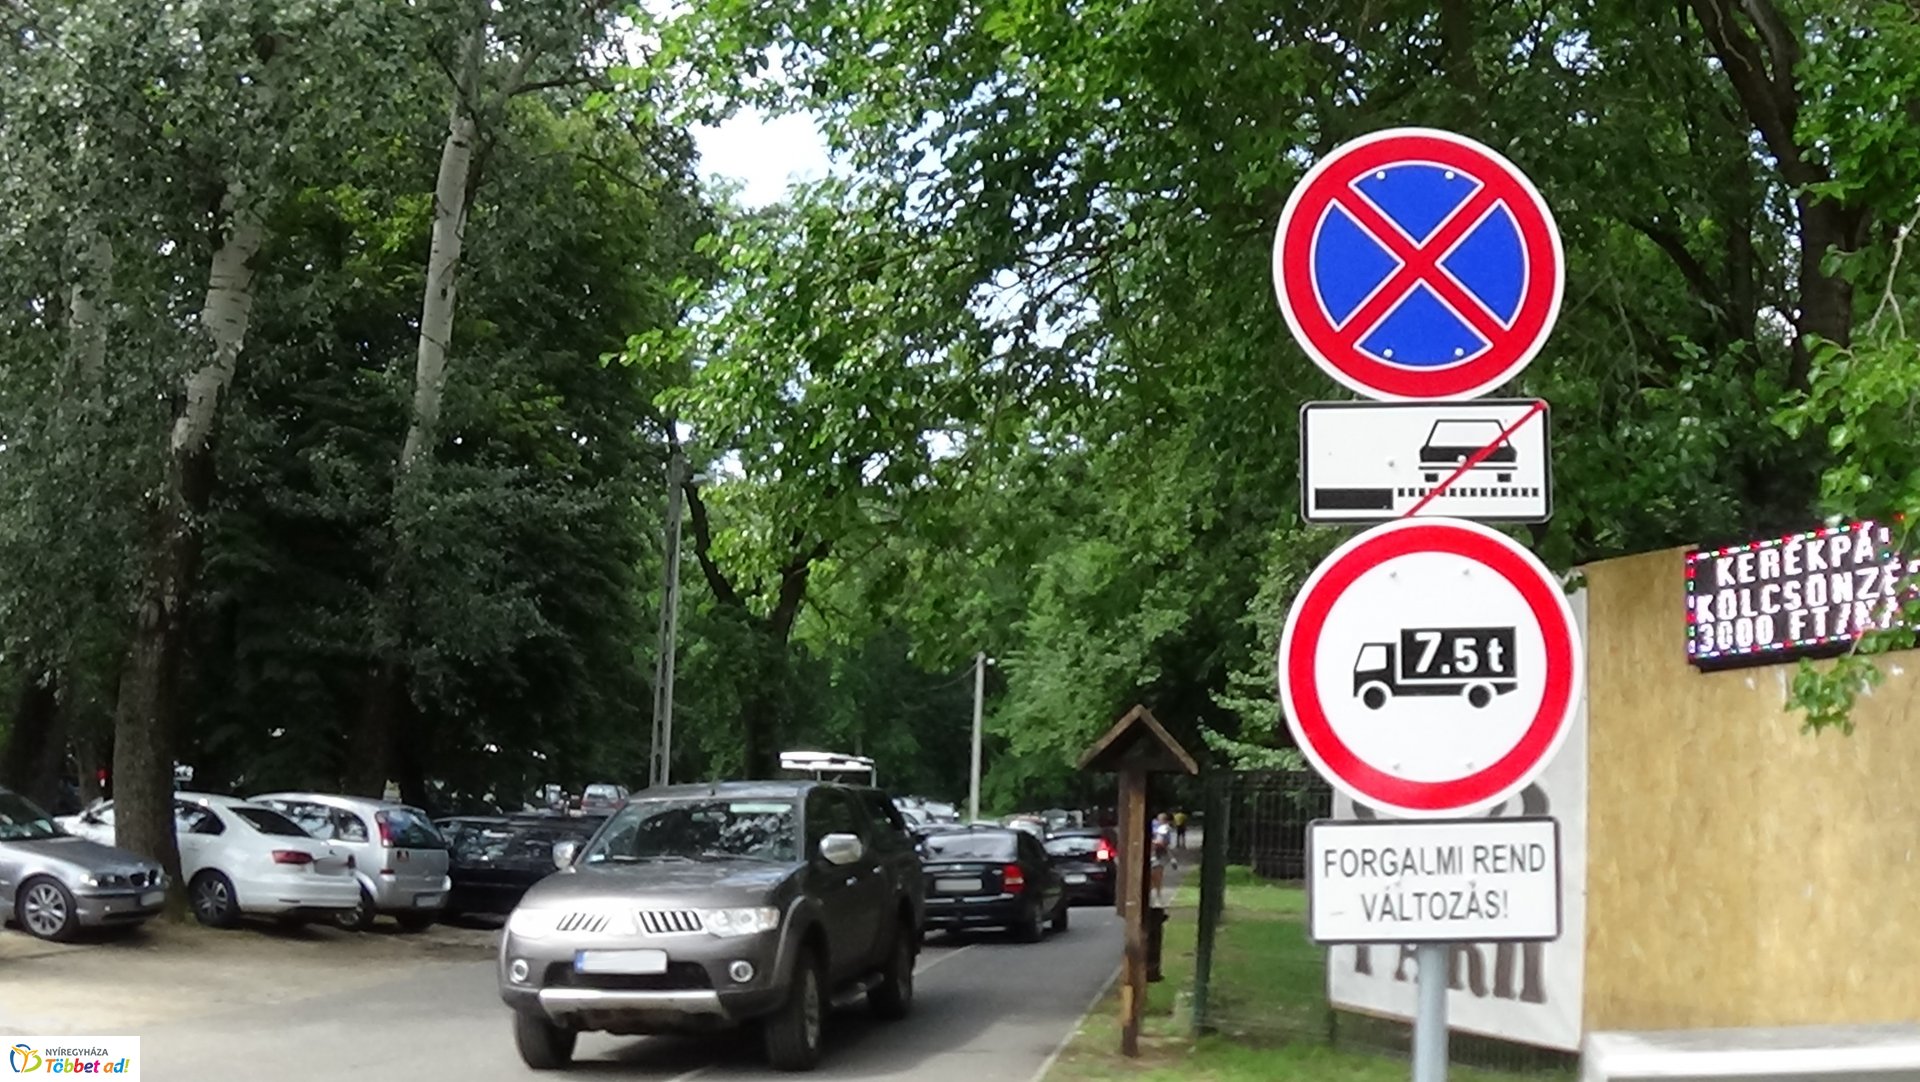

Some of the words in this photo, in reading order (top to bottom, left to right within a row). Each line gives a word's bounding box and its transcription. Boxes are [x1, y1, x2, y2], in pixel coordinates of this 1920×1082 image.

[1715, 521, 1890, 587] KERÉKPÁ
[1414, 631, 1479, 674] 7.5
[1486, 637, 1504, 672] t
[1697, 614, 1774, 653] 3000
[1323, 846, 1463, 878] FORGALMI
[1473, 843, 1546, 874] REND
[1360, 885, 1509, 922] VÁLTOZÁS!
